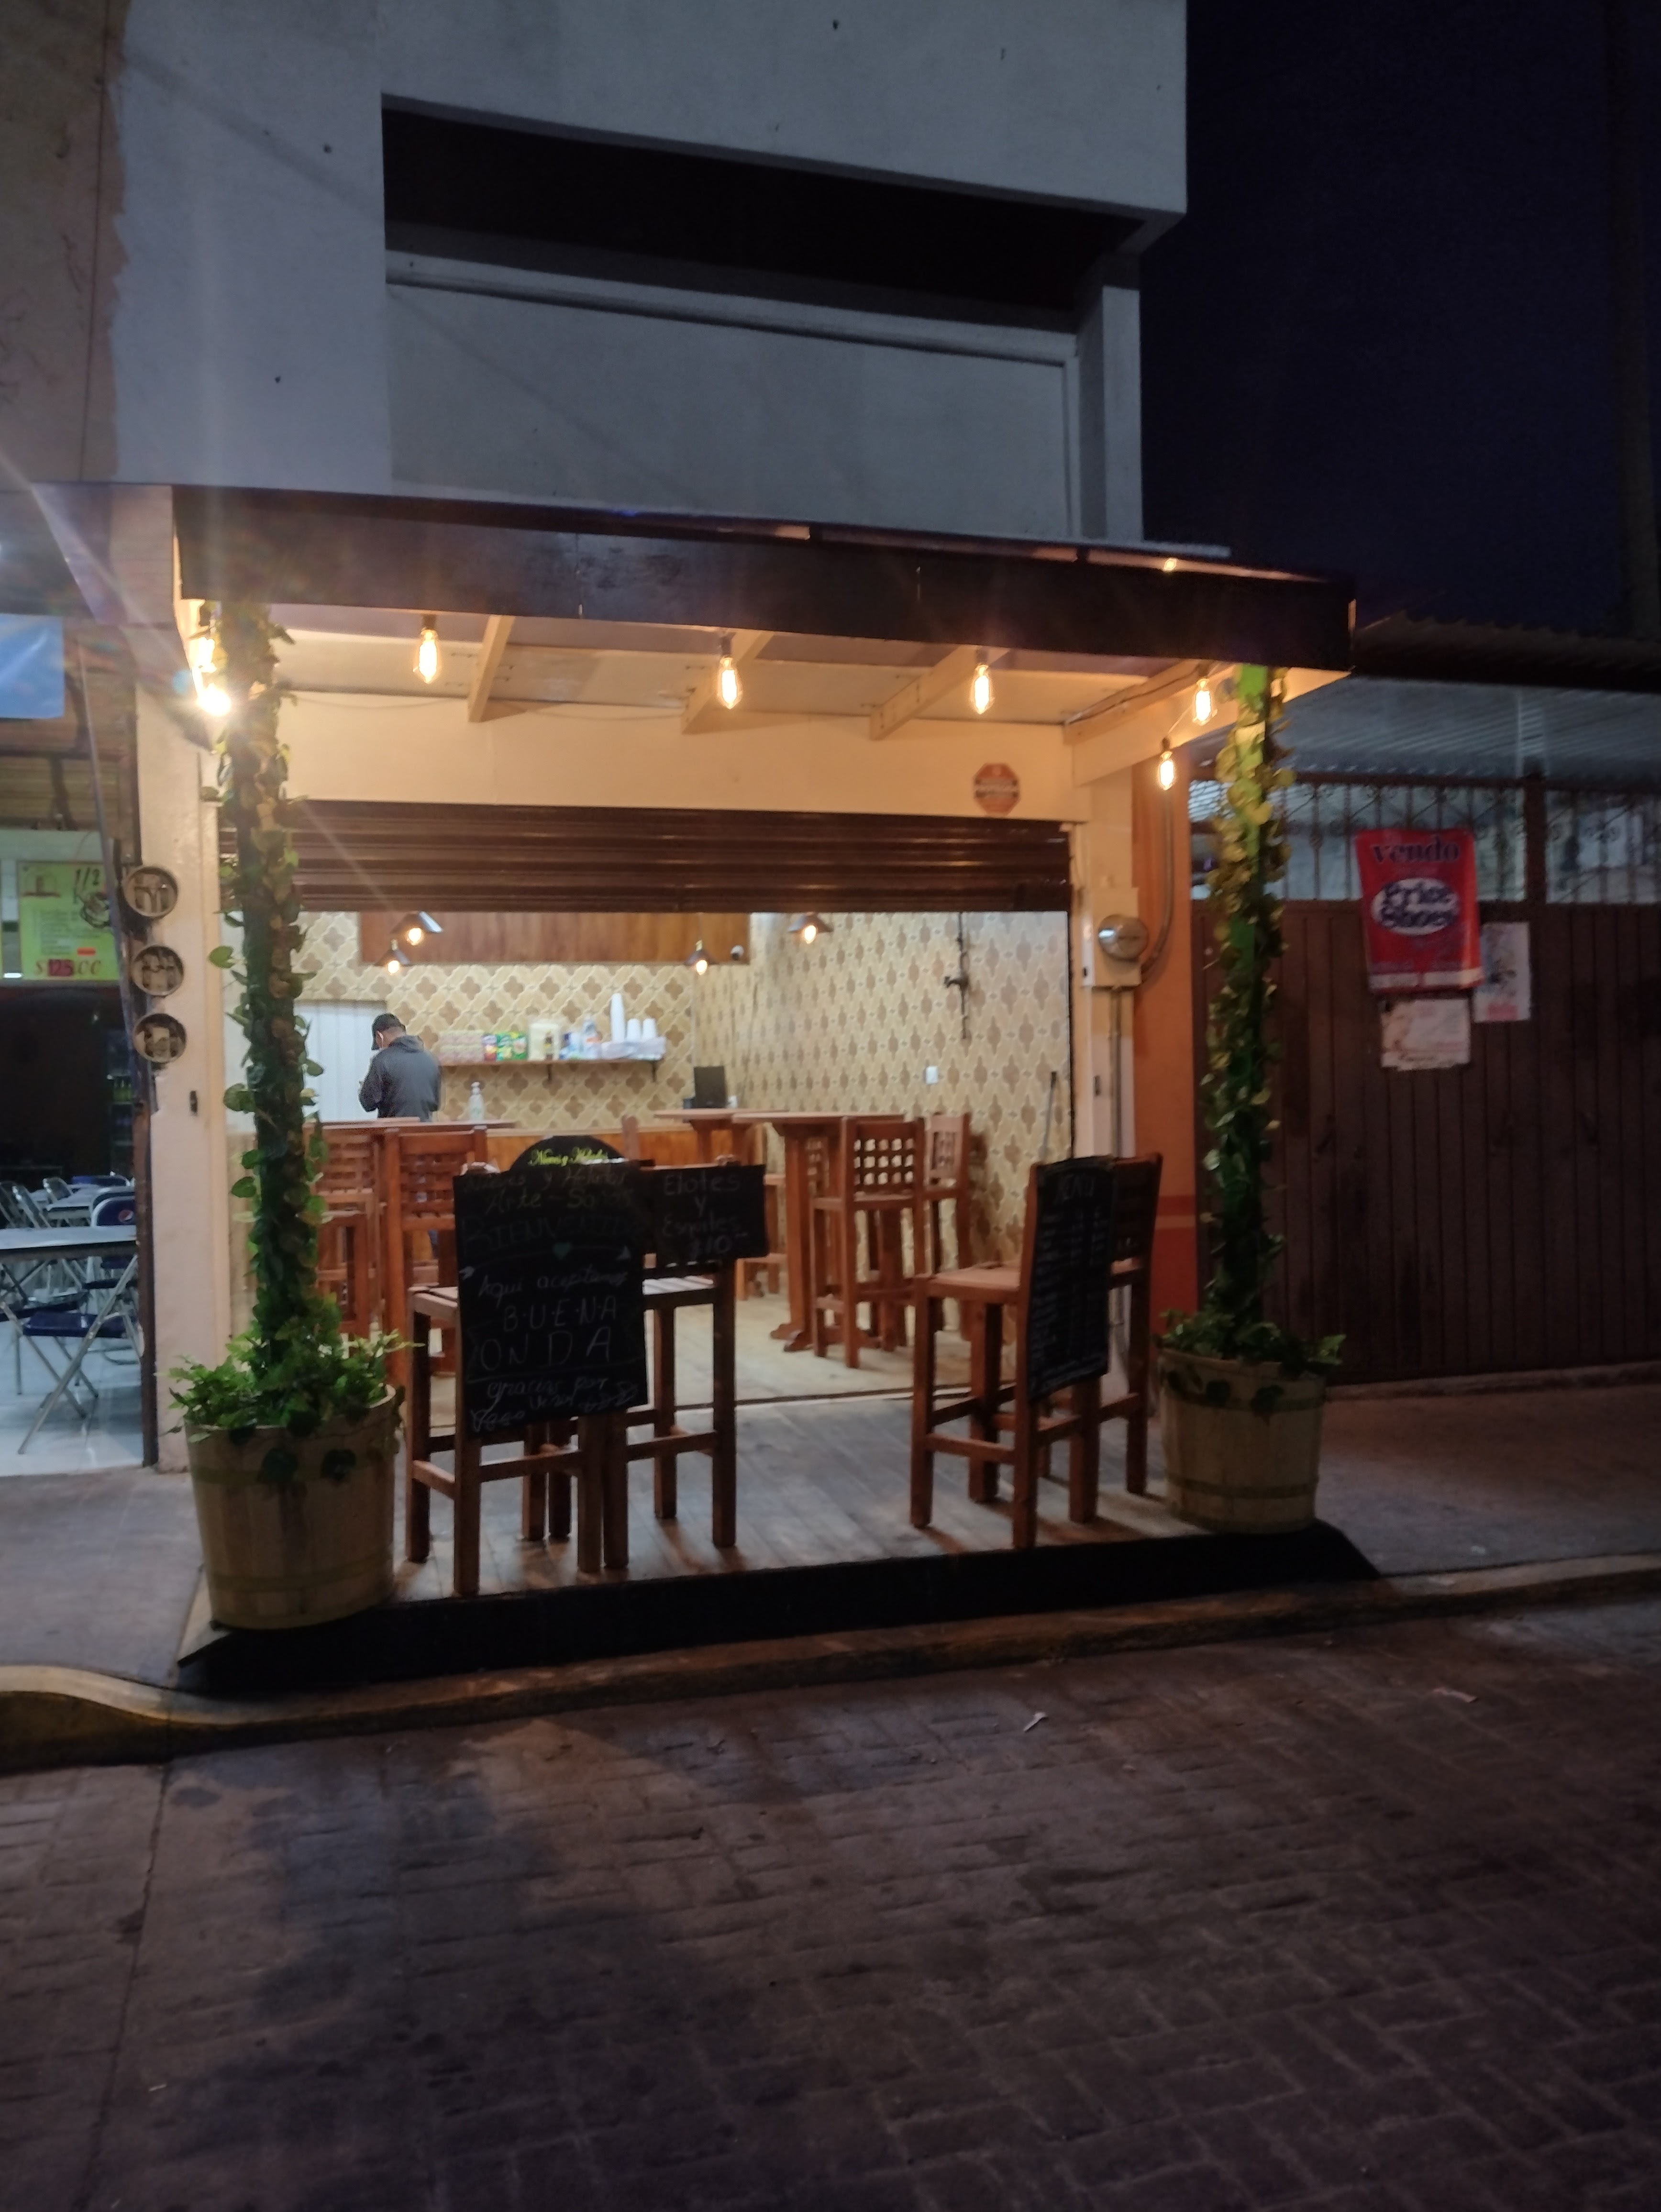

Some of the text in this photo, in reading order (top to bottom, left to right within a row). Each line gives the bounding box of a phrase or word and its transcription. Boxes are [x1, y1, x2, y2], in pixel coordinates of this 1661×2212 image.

[1373, 836, 1460, 863] vendo
[663, 1171, 741, 1196] Elotes
[480, 1327, 612, 1371] ONDA
